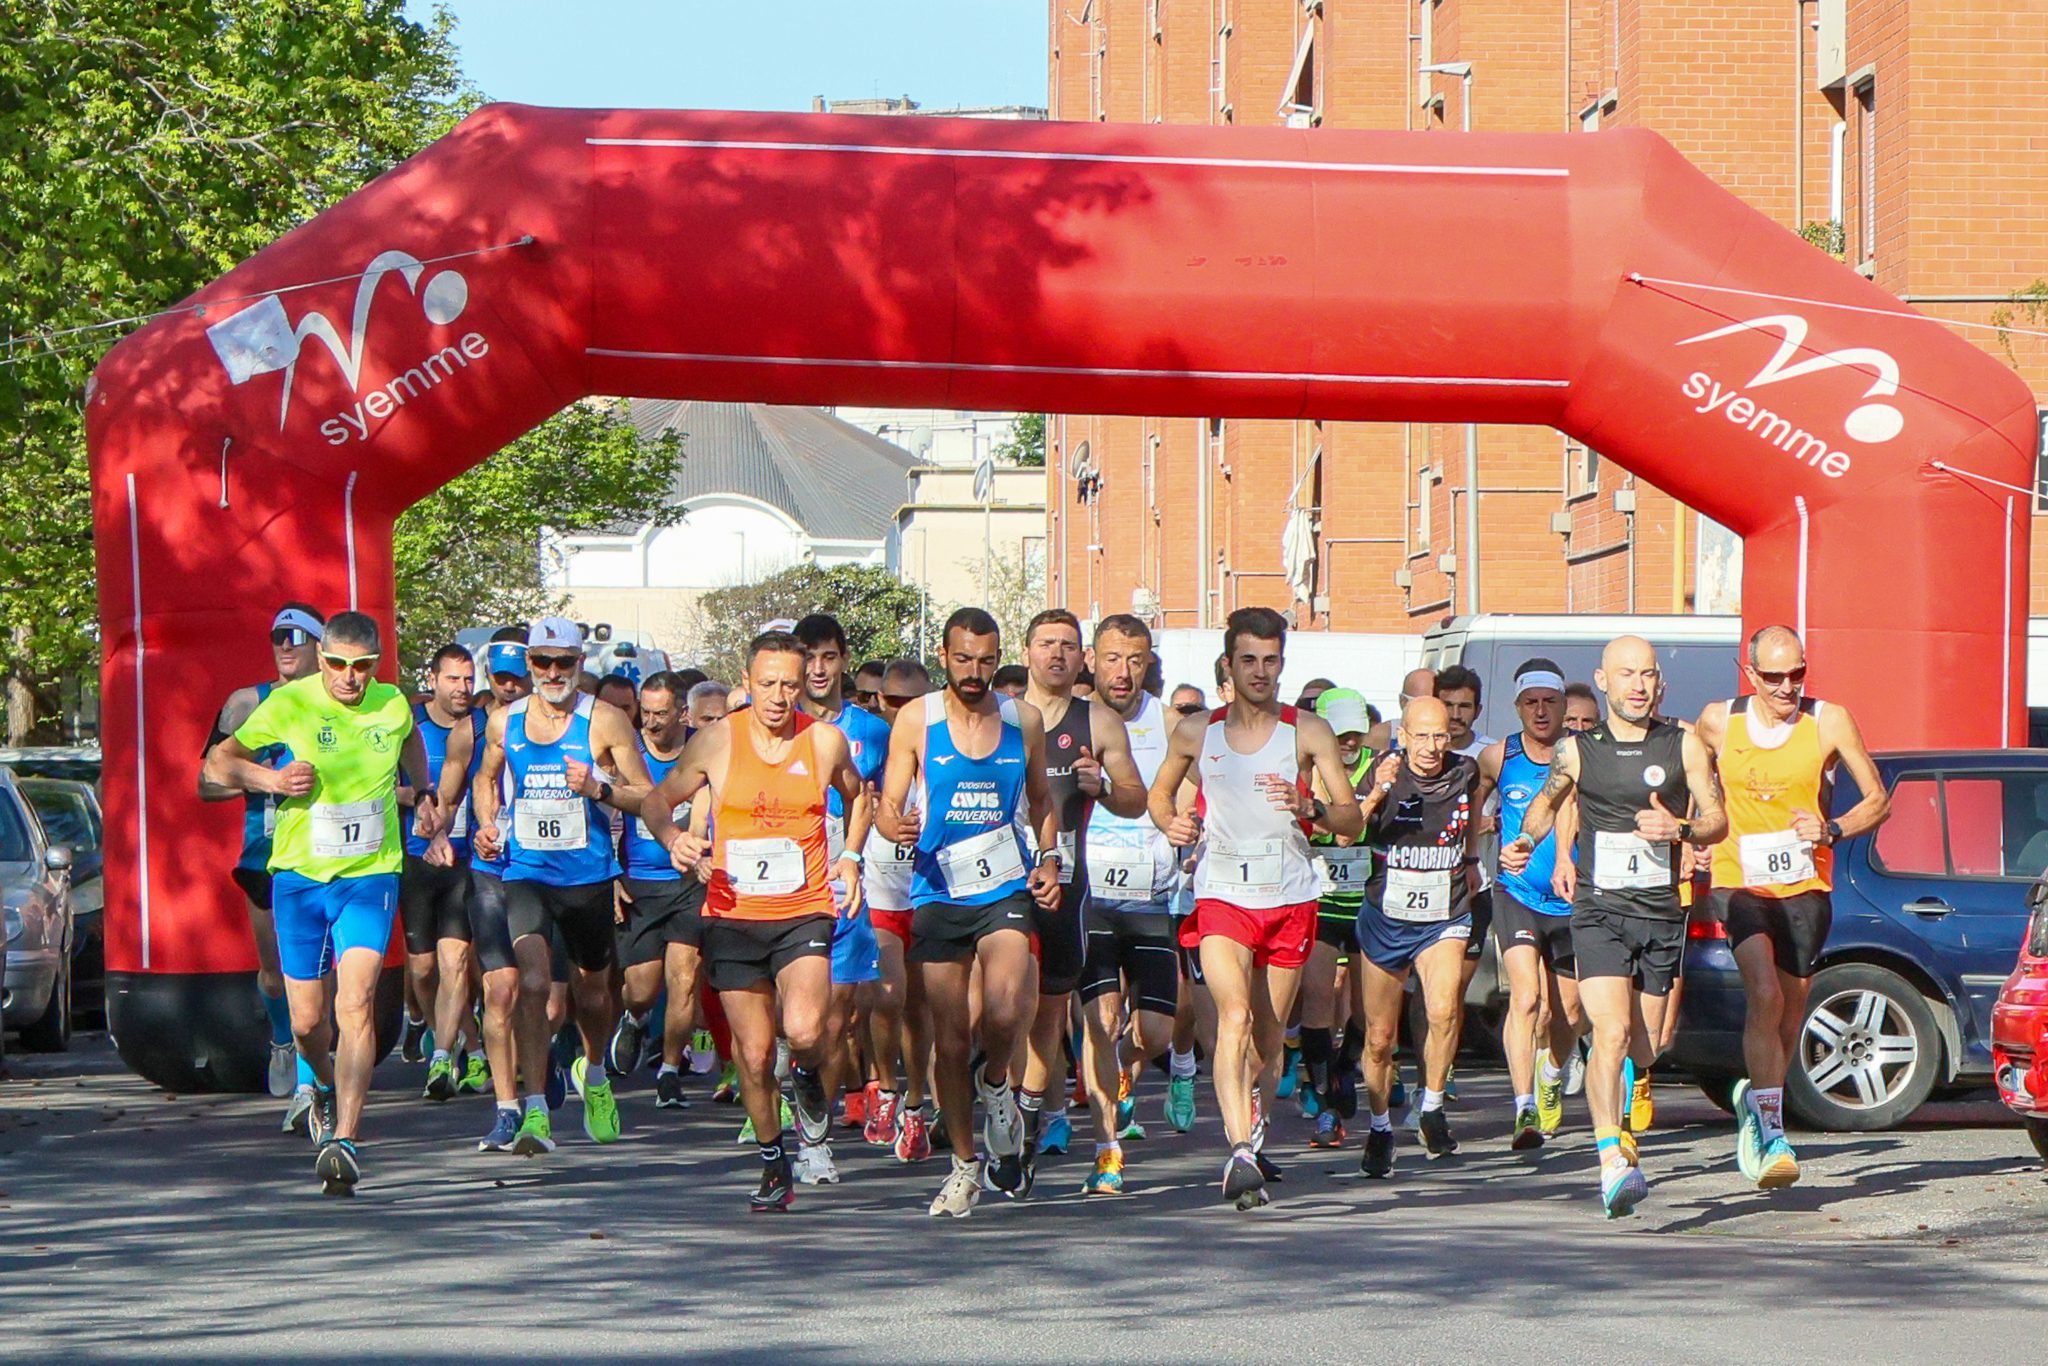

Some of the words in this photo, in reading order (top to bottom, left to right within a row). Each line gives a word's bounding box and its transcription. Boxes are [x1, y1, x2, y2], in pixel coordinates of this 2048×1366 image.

[320, 332, 489, 445] syemme
[1681, 371, 1851, 478] syemme
[523, 773, 567, 788] AVIS
[957, 781, 996, 790] PODISTICA
[523, 789, 572, 799] PRIVERNO
[951, 792, 1000, 808] AVIS
[945, 810, 1003, 822] PRIVERNO
[342, 823, 361, 842] 17
[538, 820, 561, 838] 86
[757, 861, 769, 880] 2
[976, 858, 992, 878] 3
[1628, 855, 1639, 874] 4
[1768, 851, 1792, 872] 89
[1105, 868, 1129, 887] 42
[1240, 862, 1249, 882] 1
[1329, 864, 1349, 881] 24
[1406, 891, 1429, 909] 25
